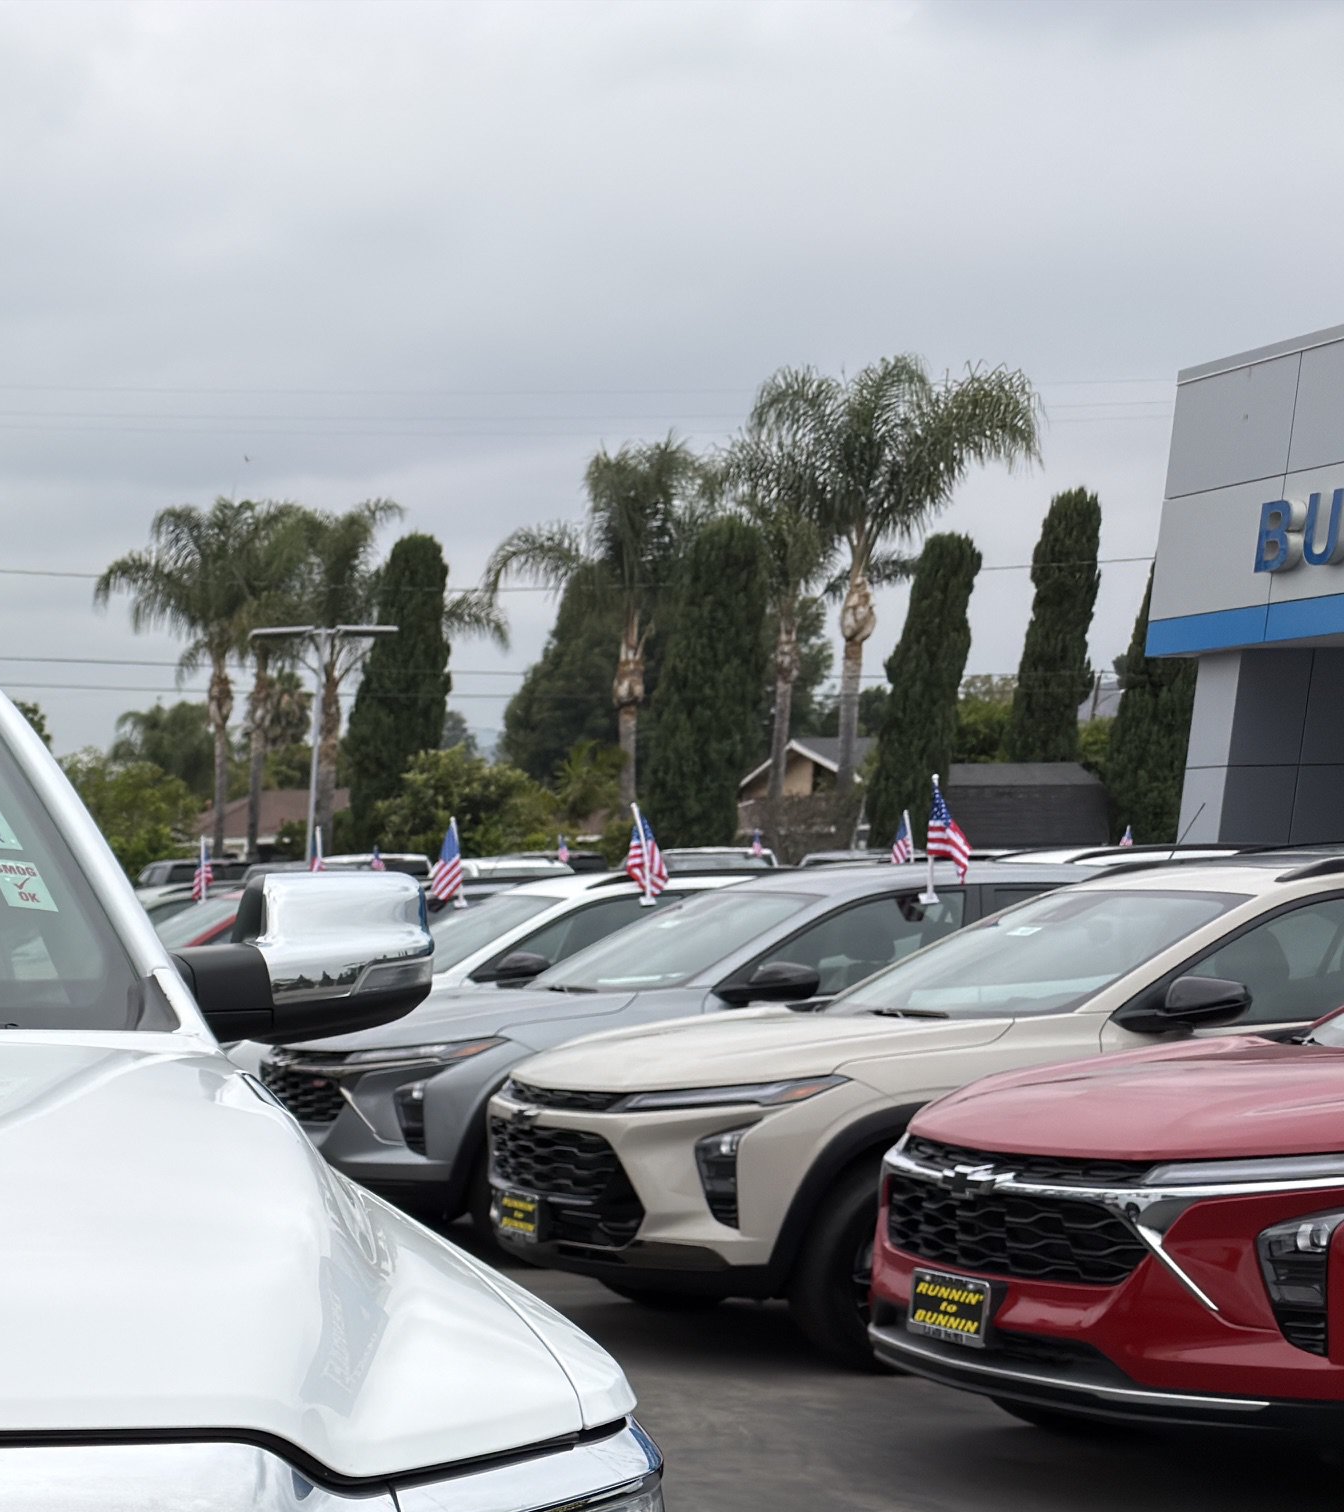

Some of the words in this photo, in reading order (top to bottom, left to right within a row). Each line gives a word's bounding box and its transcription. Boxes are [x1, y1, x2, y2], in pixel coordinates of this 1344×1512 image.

[18, 892, 40, 903] OK
[916, 1281, 984, 1305] RUNNIN'
[939, 1301, 957, 1313] to
[914, 1308, 979, 1333] BUNNIN
